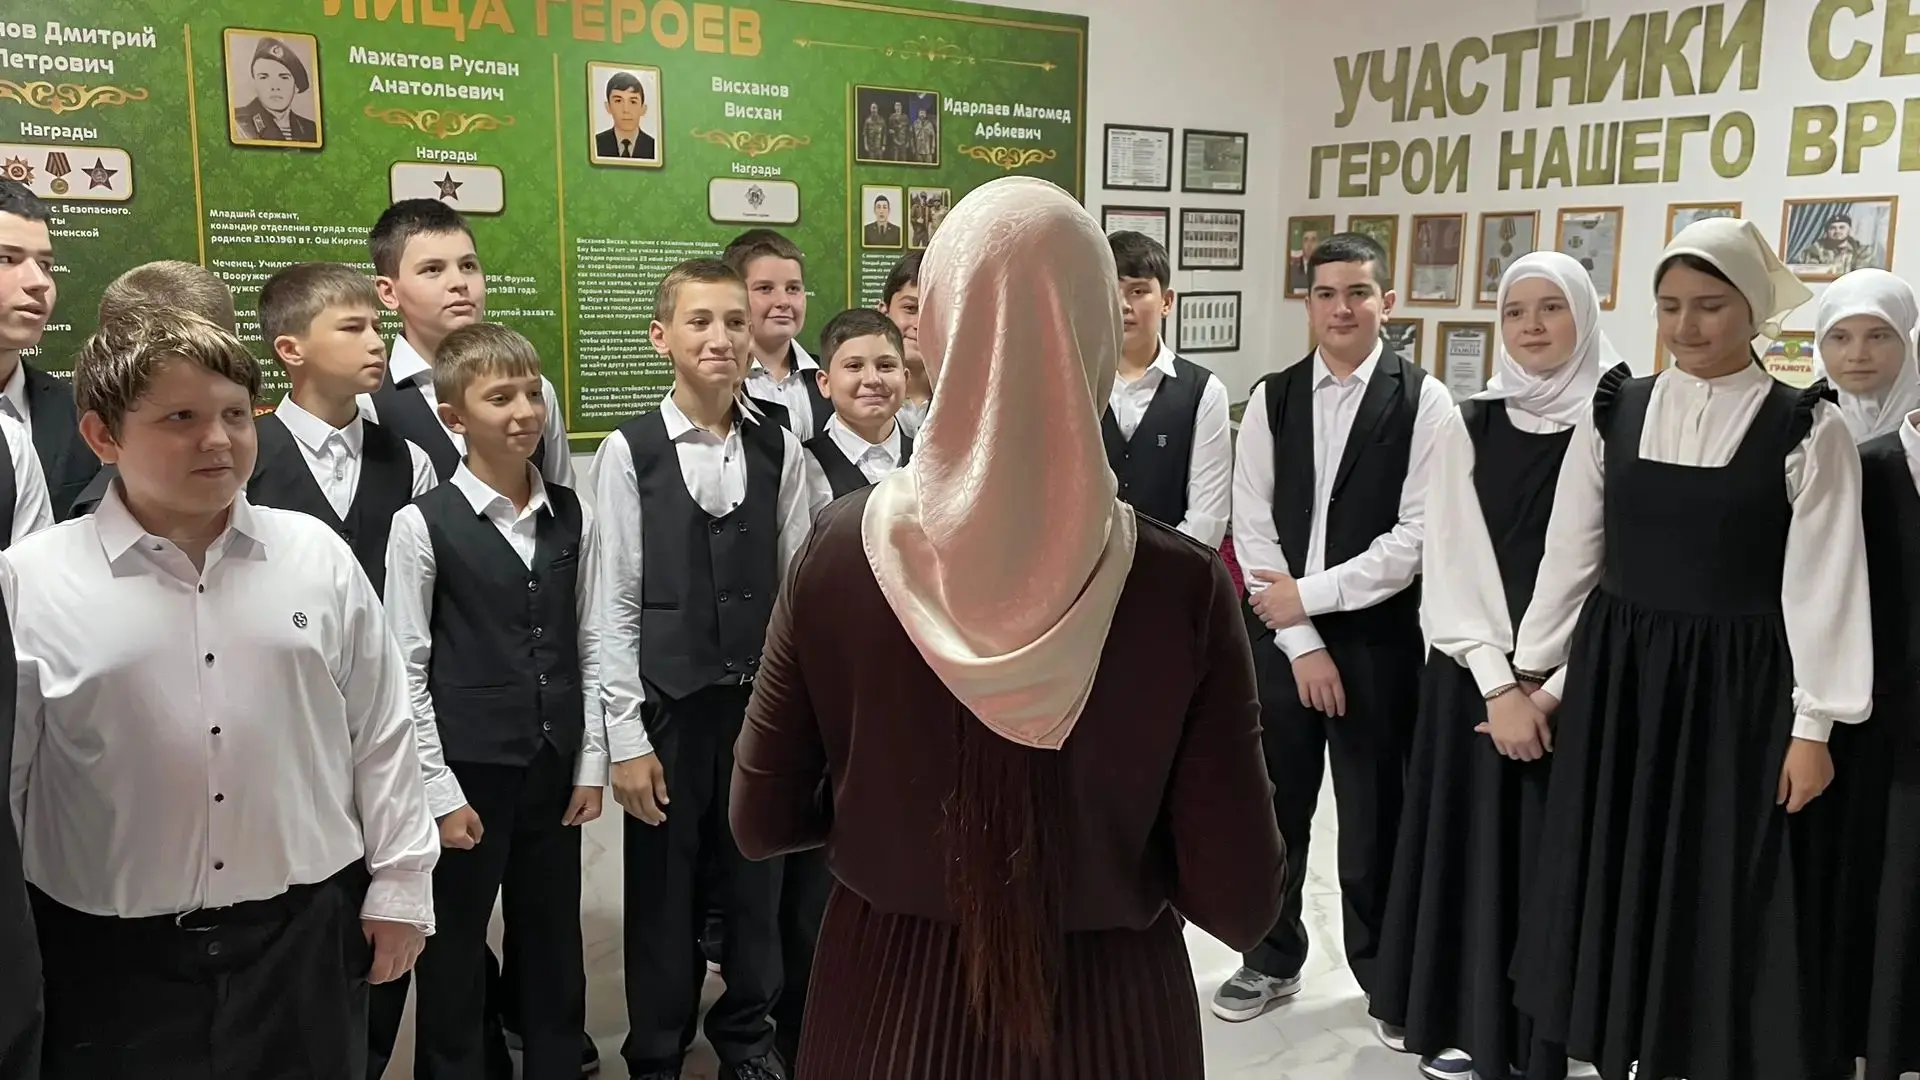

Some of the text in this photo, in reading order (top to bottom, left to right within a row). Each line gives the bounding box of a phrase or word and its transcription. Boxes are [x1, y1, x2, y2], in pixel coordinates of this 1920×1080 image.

[45, 22, 157, 50] Дмитрий
[536, 0, 762, 56] ГЕРОЕВ
[349, 46, 520, 77] Мажатов Руслан
[1333, 0, 1765, 129] УЧАСТНИКИ
[368, 75, 504, 101] Анатольевич
[711, 76, 789, 98] Висханов
[724, 102, 782, 121] Висхан
[943, 97, 1071, 124] Идарлаев Магомед
[20, 121, 98, 141] Награды
[975, 122, 1042, 141] Арбиевич
[416, 146, 478, 162] Награды
[1309, 133, 1471, 200] ГЕРОИ
[1497, 111, 1756, 191] НАШЕГО
[732, 162, 781, 178] Награды
[62, 205, 132, 215] Безопасного.
[210, 209, 300, 222] Младший сержант,
[211, 223, 258, 233] командир
[261, 224, 311, 233] отделения
[313, 226, 345, 234] отряда
[211, 235, 252, 245] родился
[254, 235, 296, 244] 21.10.1961
[315, 236, 330, 244] Ош
[213, 259, 257, 270] Чеченец.
[222, 272, 273, 282] Вооружен
[504, 275, 537, 284] Фрунзе.
[499, 286, 517, 294] 1981
[518, 288, 538, 296] года.
[487, 308, 521, 318] группой
[522, 310, 557, 318] захвата.
[1769, 363, 1812, 373] ГРАМОТА
